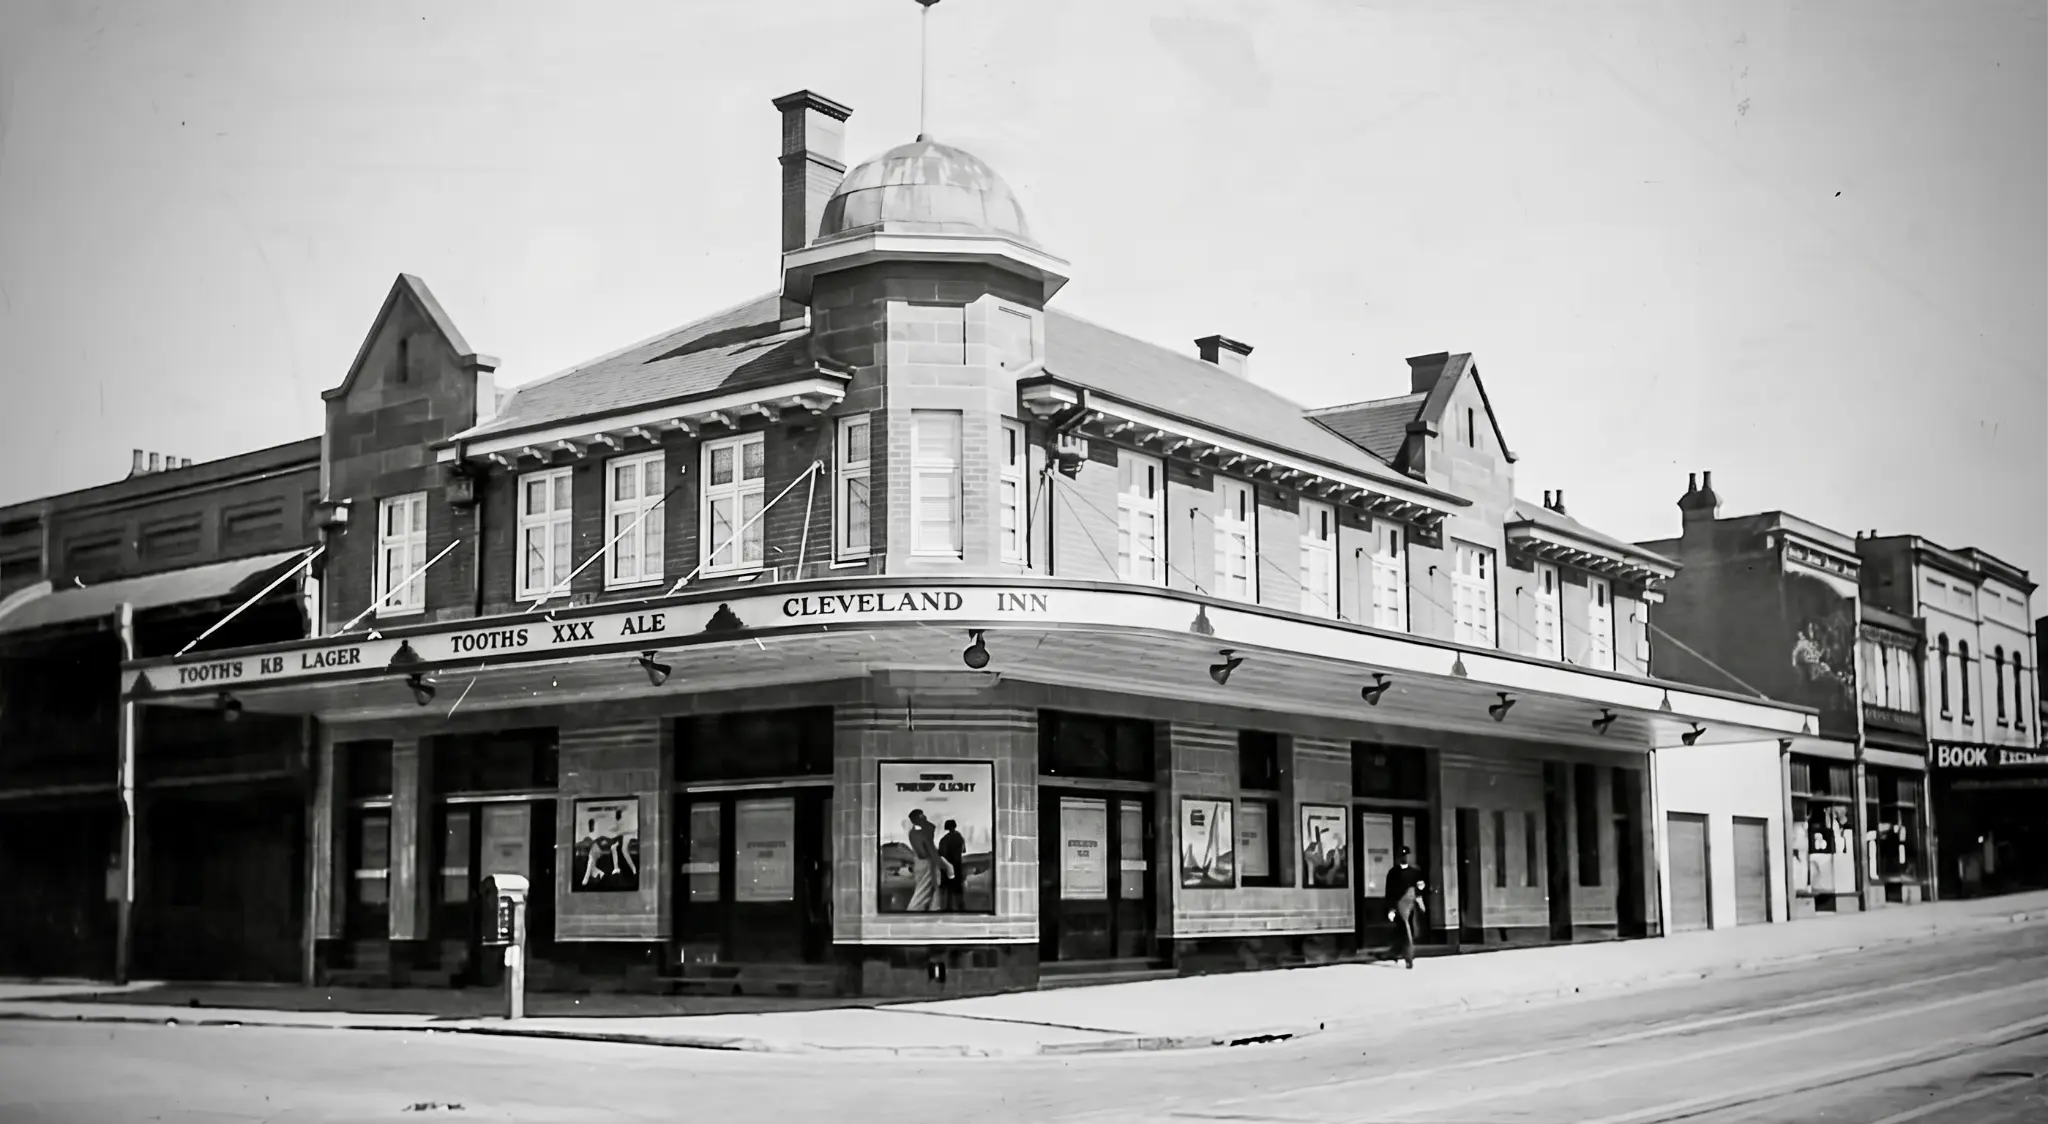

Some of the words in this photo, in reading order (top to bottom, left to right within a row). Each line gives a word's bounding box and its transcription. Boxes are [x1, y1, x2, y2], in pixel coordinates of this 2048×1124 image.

[783, 592, 963, 617] CLEVELAND
[997, 593, 1048, 612] INN
[451, 629, 528, 653] TOOTHS
[552, 621, 594, 643] XXX
[620, 613, 665, 635] ALE
[260, 657, 284, 675] KB
[301, 648, 361, 669] LAGER
[1938, 746, 1987, 768] BOOK
